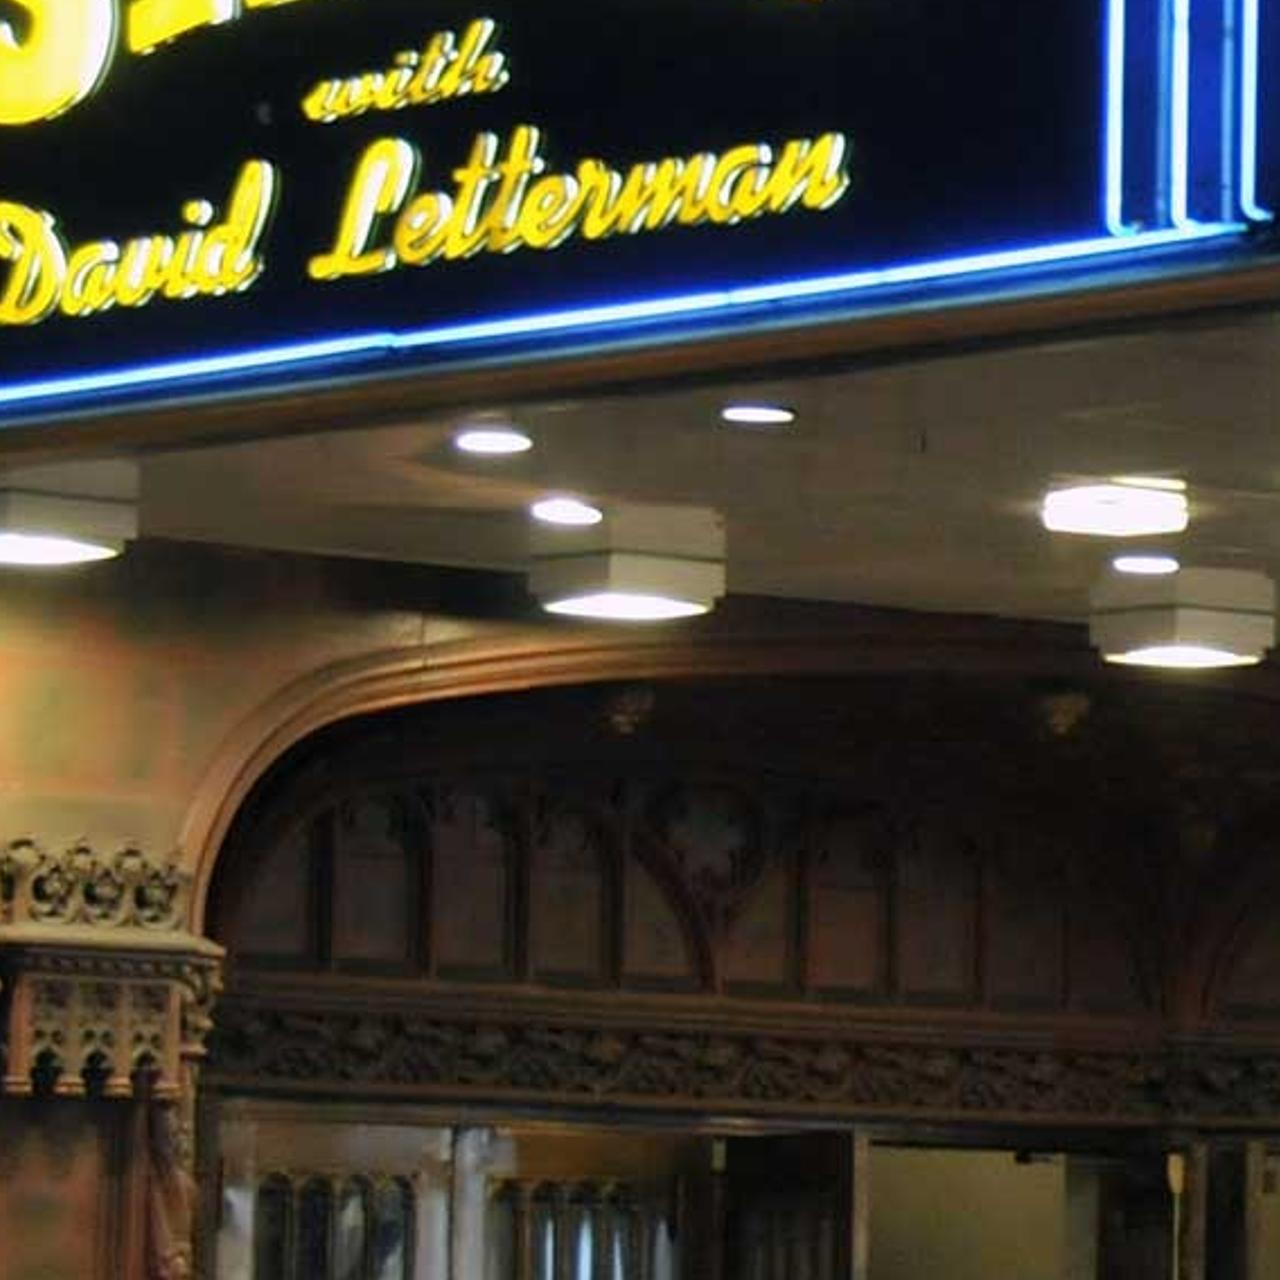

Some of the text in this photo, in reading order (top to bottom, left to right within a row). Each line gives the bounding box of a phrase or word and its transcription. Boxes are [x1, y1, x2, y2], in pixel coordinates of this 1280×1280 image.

[302, 17, 509, 122] with
[0, 125, 850, 325] David Letterman
